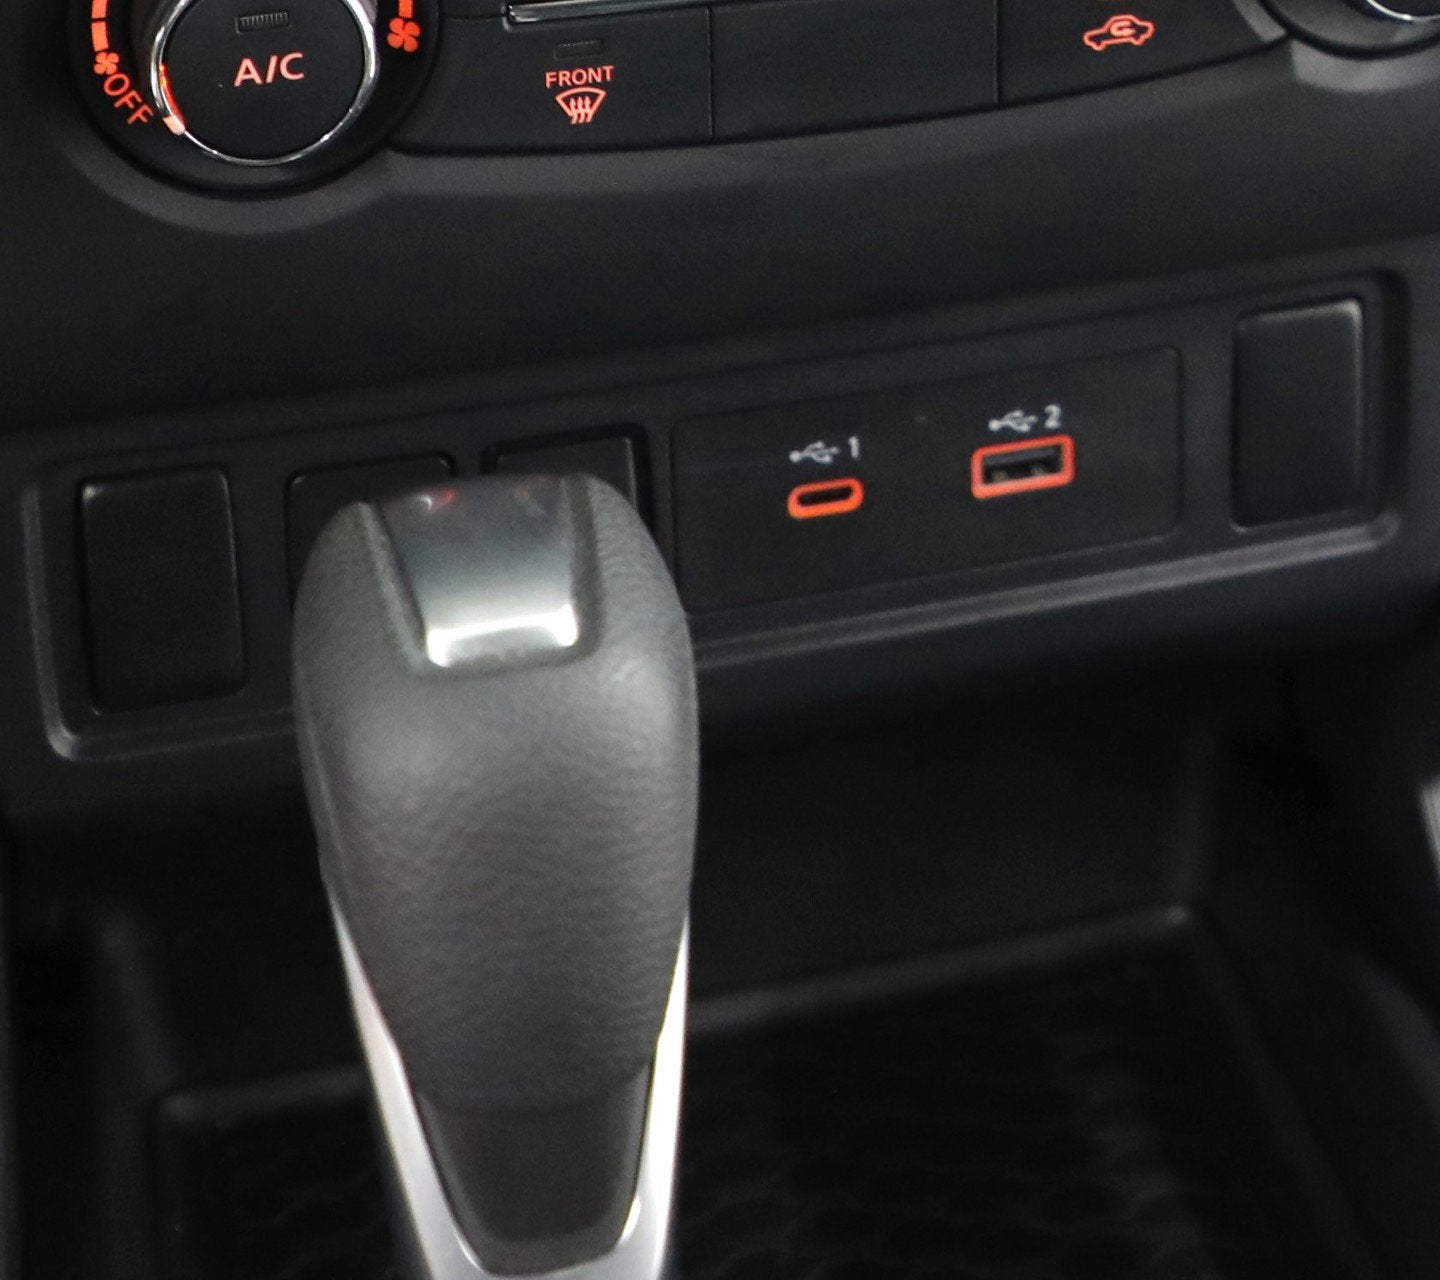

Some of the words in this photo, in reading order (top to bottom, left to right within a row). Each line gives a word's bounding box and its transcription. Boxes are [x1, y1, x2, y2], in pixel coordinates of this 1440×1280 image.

[233, 51, 305, 87] A/C
[545, 65, 614, 88] FRONT
[103, 71, 154, 127] OFF
